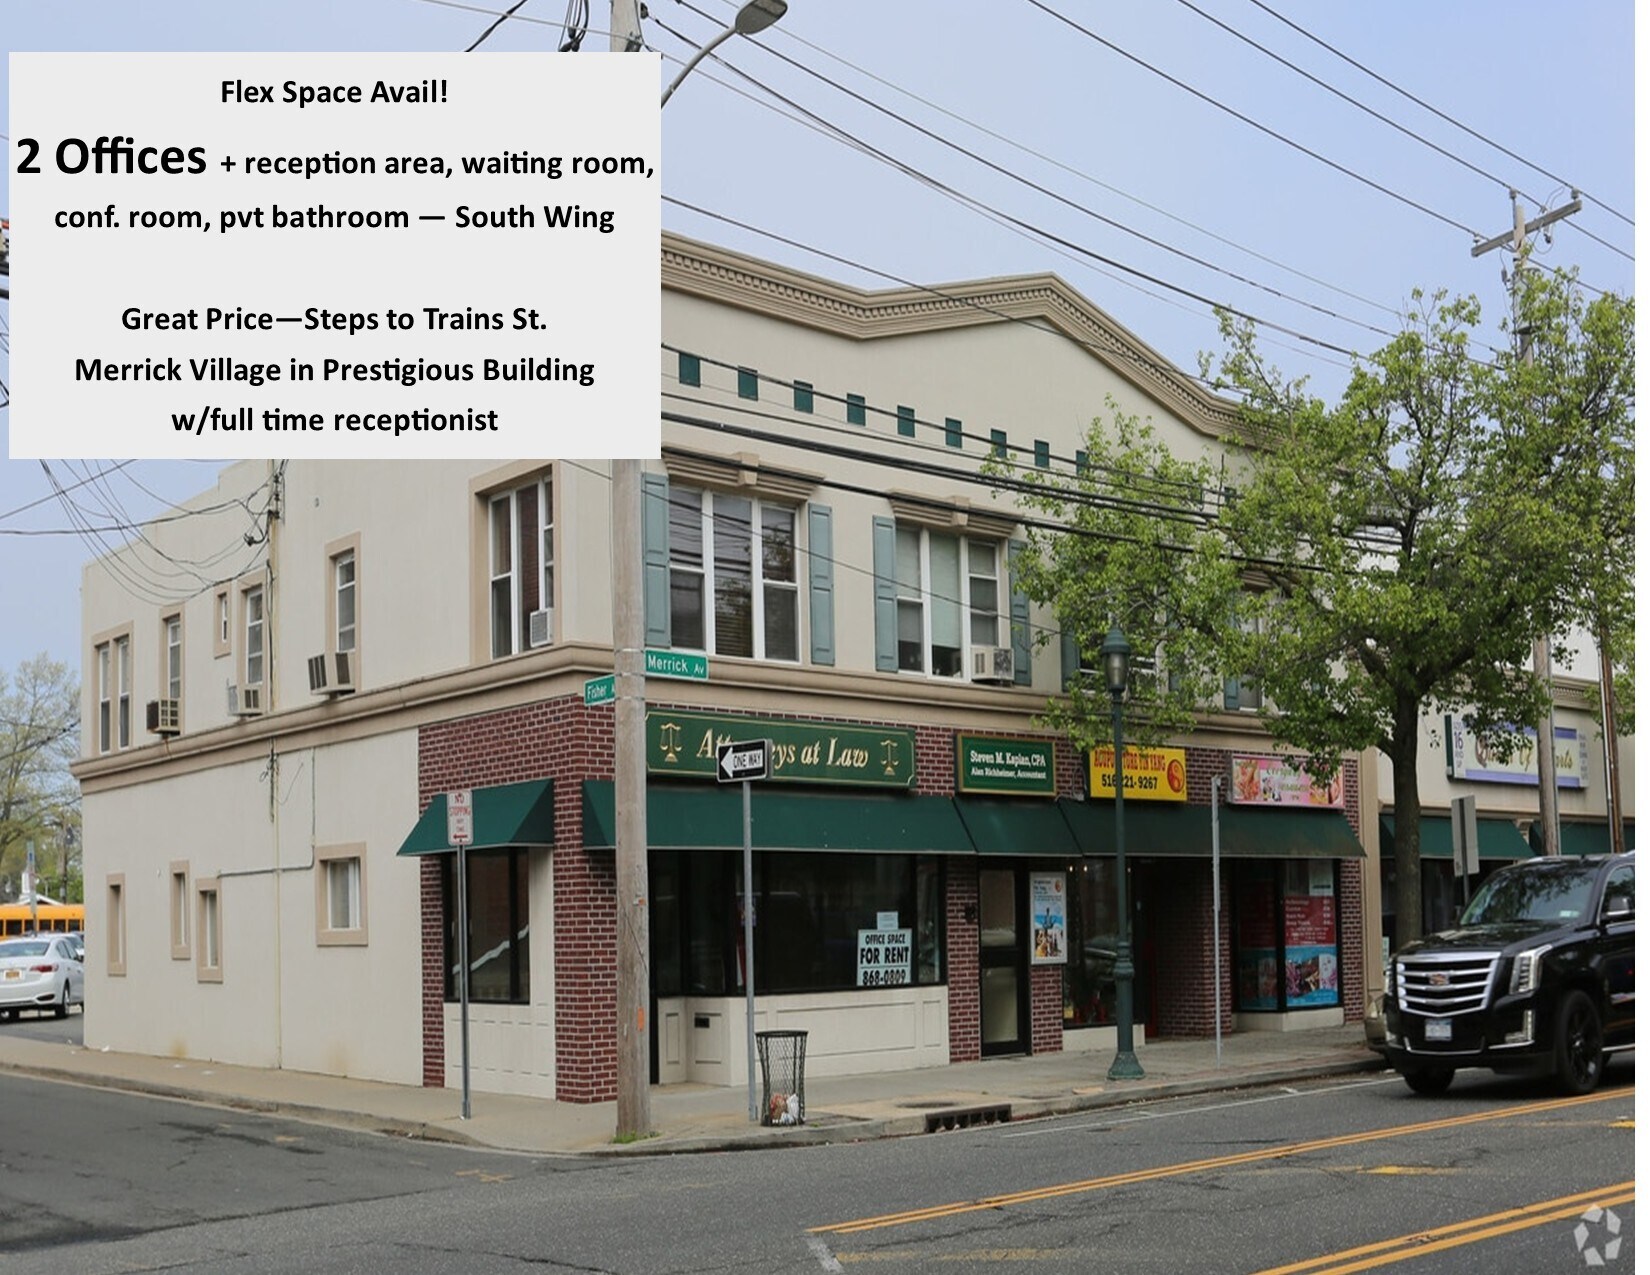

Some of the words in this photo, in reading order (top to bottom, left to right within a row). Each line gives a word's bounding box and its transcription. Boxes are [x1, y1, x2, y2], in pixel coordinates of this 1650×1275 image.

[648, 654, 688, 672] Merrick
[693, 665, 704, 675] Av
[587, 684, 607, 699] Fisher
[696, 728, 796, 767] Ateys
[800, 741, 821, 765] at
[826, 737, 869, 769] Law
[1454, 731, 1464, 749] 16
[733, 754, 747, 769] ONE
[748, 751, 762, 767] WAY
[970, 749, 994, 763] Steven
[995, 751, 1004, 764] M.
[1005, 752, 1031, 767] Kaplan,
[1031, 753, 1046, 767] CPA
[1094, 749, 1138, 770] ACUPUTURE
[971, 767, 984, 776] Alan
[1017, 769, 1047, 779] Accountant
[1102, 774, 1158, 790] 51621-9267
[454, 793, 465, 804] NO
[448, 806, 471, 816] STOPPING
[865, 934, 885, 945] OFFICE
[887, 933, 906, 944] SPACE
[860, 947, 880, 964] FOR
[884, 946, 909, 963] RENT
[863, 969, 907, 985] 868-0809
